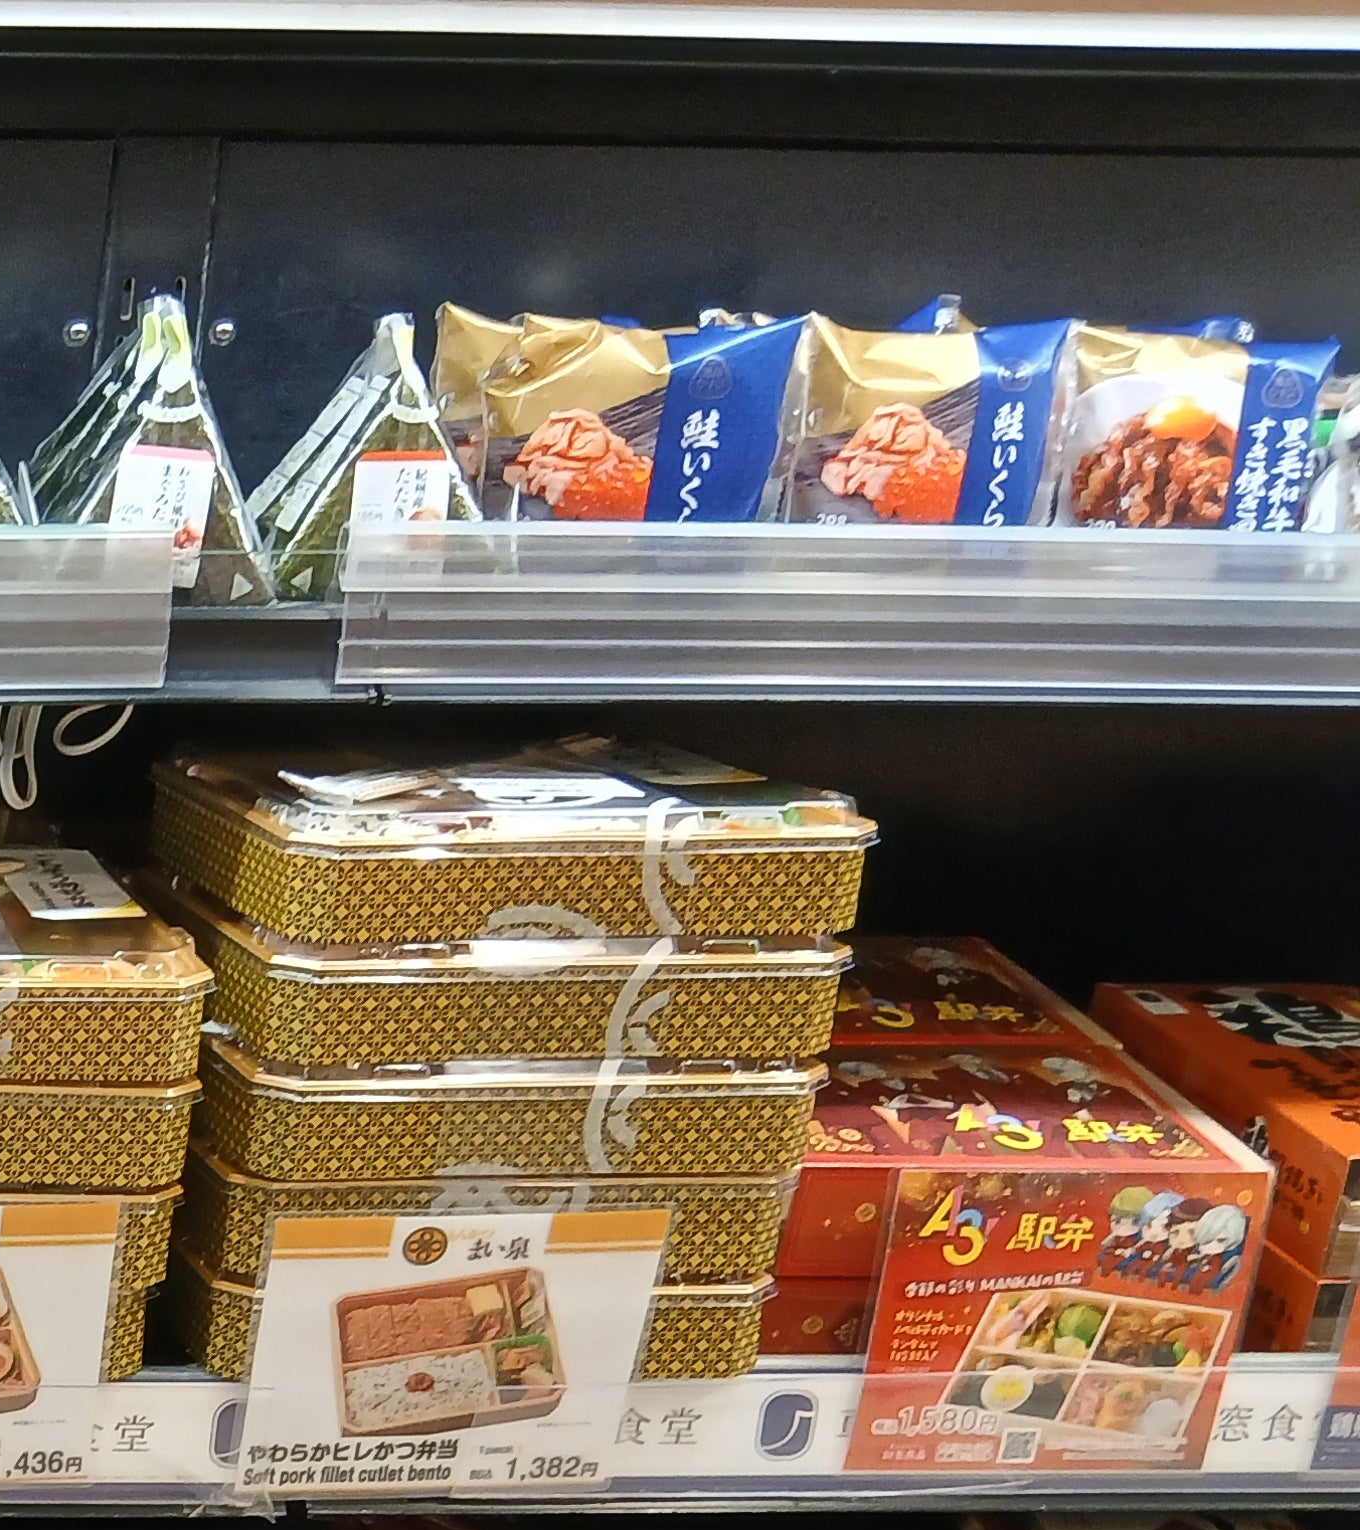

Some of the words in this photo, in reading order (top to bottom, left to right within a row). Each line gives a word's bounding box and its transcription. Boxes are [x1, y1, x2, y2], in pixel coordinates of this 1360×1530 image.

[981, 401, 1025, 528] 鮭いくら
[1006, 1213, 1094, 1253] 駅弁
[615, 1408, 703, 1446] 食堂
[1213, 1405, 1316, 1443] 窓食
[247, 1438, 459, 1463] やわらかヒレかつ弁当
[505, 1456, 598, 1482] 1,382円
[243, 1466, 276, 1487] Soft
[279, 1466, 316, 1486] pork
[319, 1464, 354, 1483] fillet
[357, 1464, 403, 1482] cutlet
[407, 1463, 452, 1482] bento
